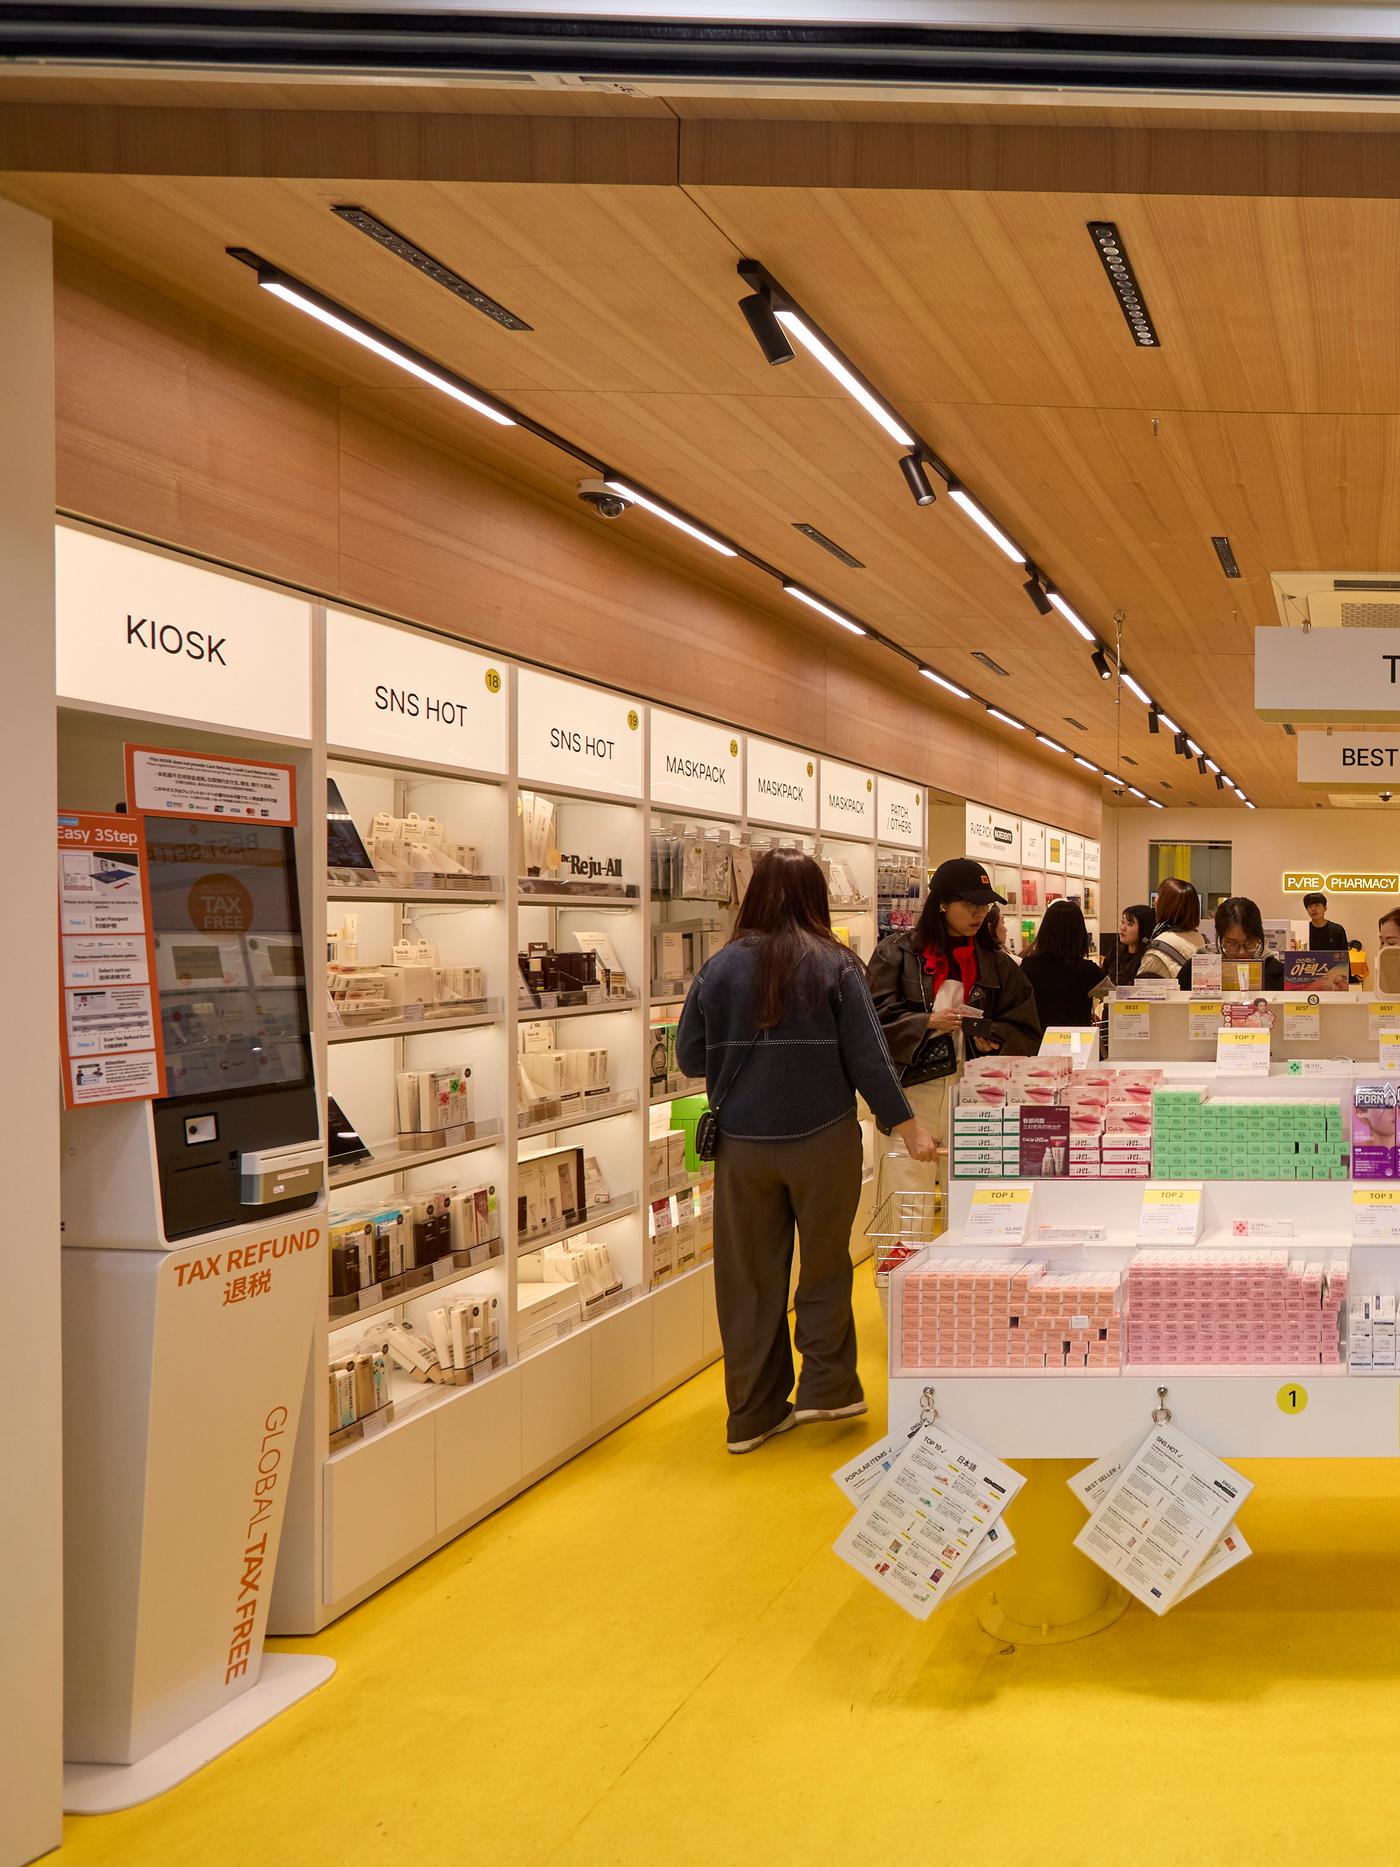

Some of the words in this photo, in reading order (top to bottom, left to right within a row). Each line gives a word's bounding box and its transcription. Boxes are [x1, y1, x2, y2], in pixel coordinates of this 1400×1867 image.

[126, 614, 227, 666] KIOSK
[486, 673, 499, 688] 18
[374, 685, 420, 717] SNS
[426, 695, 468, 728] HOT
[627, 713, 639, 727] 19
[550, 728, 582, 753] SNS
[585, 734, 615, 761] HOT
[1342, 748, 1399, 767] BEST
[666, 755, 726, 785] MASKPACK
[757, 778, 804, 803] MASKPACK
[828, 795, 865, 815] MASKPACK
[890, 803, 909, 819] PATCH
[58, 826, 90, 843] Easy
[95, 828, 138, 846] 3Step
[1330, 876, 1397, 890] PHARMACY
[202, 896, 242, 914] TAX
[204, 915, 244, 930] FREE
[1290, 963, 1329, 976] 아렉스
[1358, 1094, 1384, 1104] PDRN
[174, 1254, 222, 1287] TAX
[226, 1227, 321, 1273] REFUND
[222, 1269, 272, 1306] 退税
[1288, 1390, 1296, 1408] 1
[923, 1435, 936, 1447] TOP
[1155, 1435, 1168, 1447] SNS
[1166, 1444, 1179, 1455] HOT
[247, 1406, 288, 1539] GLOBAL
[844, 1460, 871, 1484] POPULAR
[870, 1450, 888, 1466] ITEMS
[956, 1455, 978, 1473] 日本語
[1084, 1479, 1099, 1493] BEST
[1098, 1467, 1117, 1484] SELLER
[1221, 1479, 1239, 1494] ENGLISH
[238, 1532, 268, 1600] TAX
[224, 1599, 257, 1686] FREE
